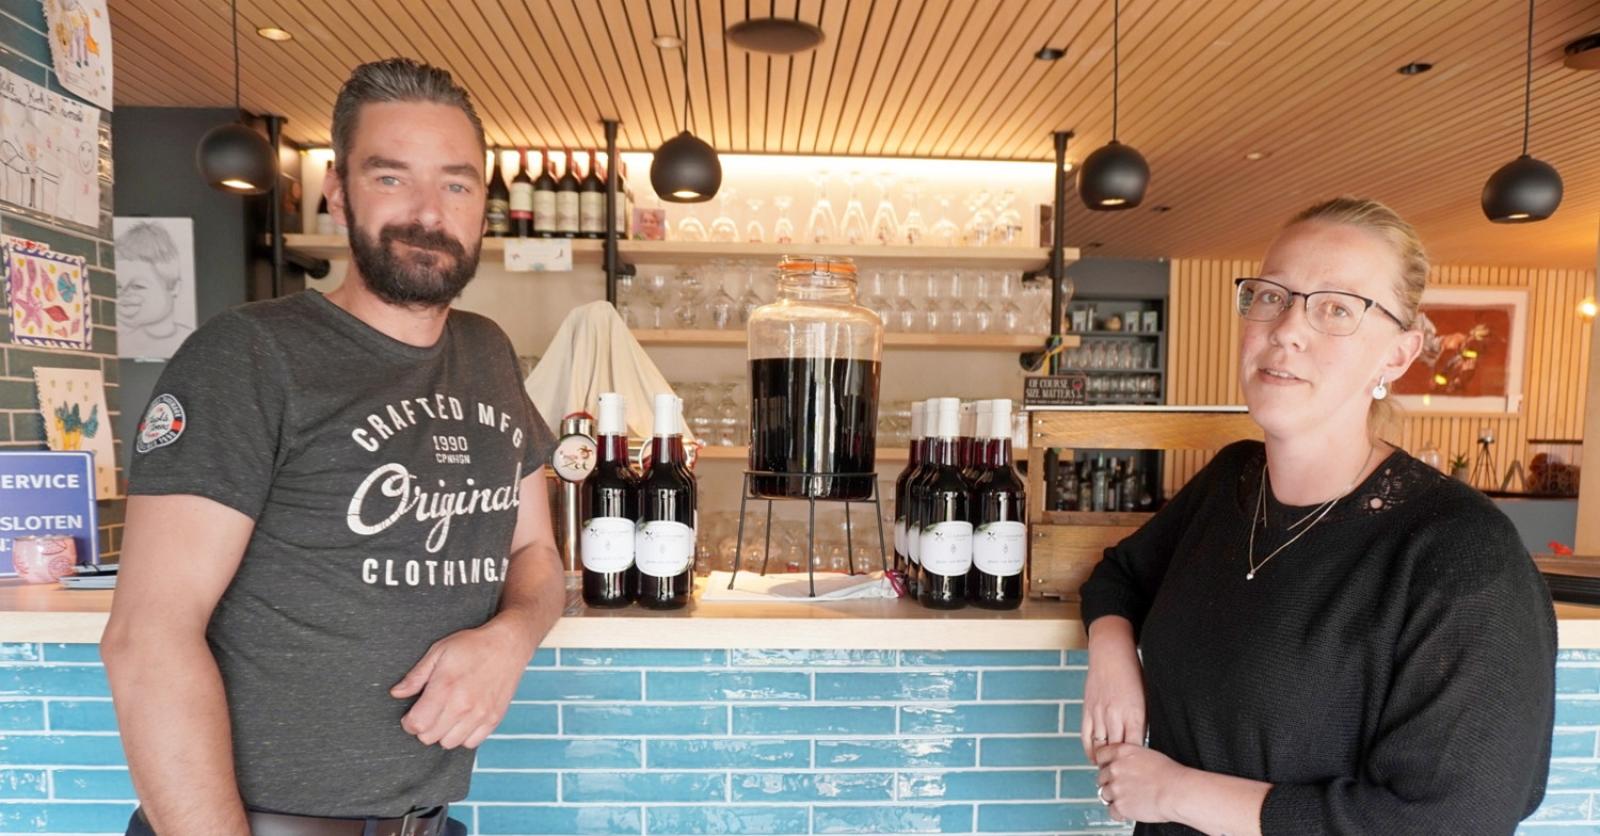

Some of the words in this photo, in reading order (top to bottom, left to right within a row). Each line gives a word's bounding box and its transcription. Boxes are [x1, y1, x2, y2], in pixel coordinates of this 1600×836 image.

[1040, 379, 1068, 388] COURSE
[1026, 388, 1040, 398] SIZE
[1042, 389, 1075, 399] MATTERS
[352, 393, 464, 452] CRAFTED
[478, 402, 523, 448] MFG
[432, 435, 469, 451] 1990
[1, 474, 80, 489] ERVICE
[347, 462, 522, 553] Original
[0, 515, 82, 531] SLOTEN
